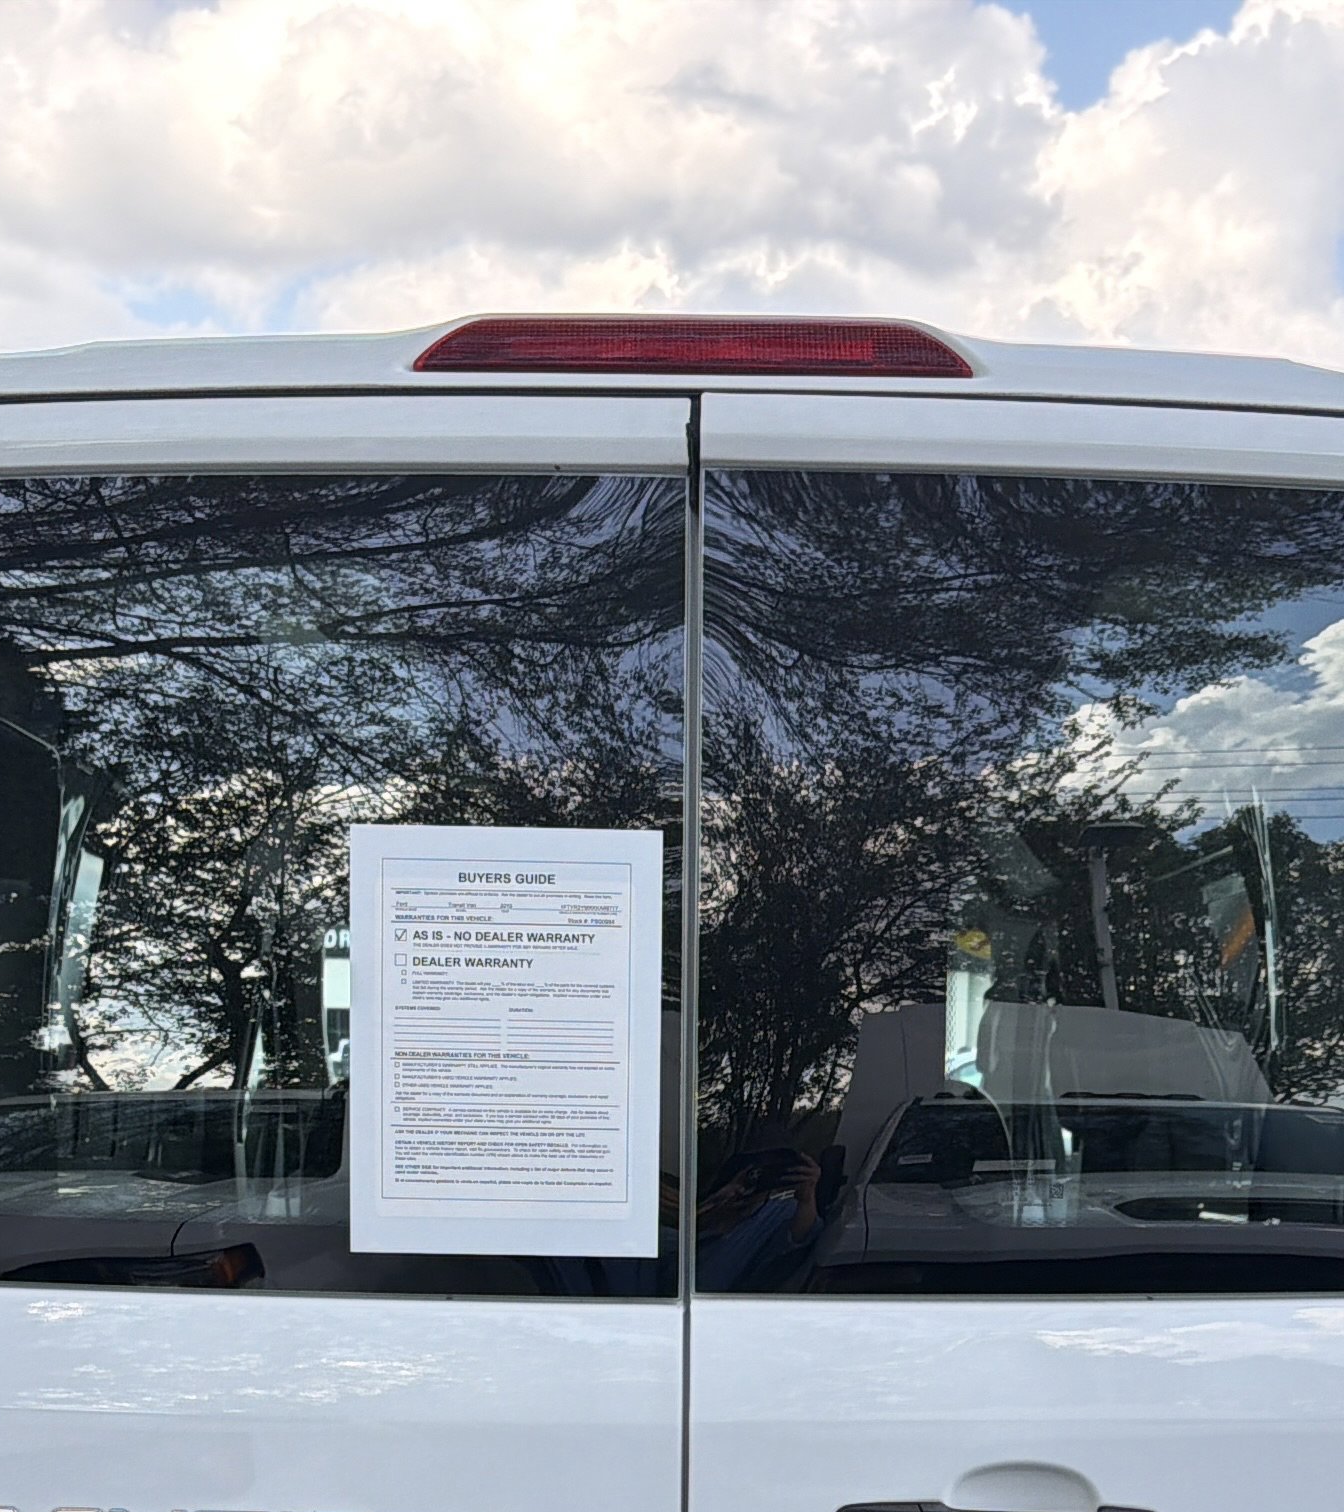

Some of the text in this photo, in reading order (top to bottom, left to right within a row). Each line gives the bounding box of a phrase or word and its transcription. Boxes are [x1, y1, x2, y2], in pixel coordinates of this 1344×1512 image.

[458, 872, 556, 885] BUYERS GUIDE
[413, 930, 428, 940] AS
[432, 930, 443, 940] IS
[454, 931, 471, 941] NO
[475, 931, 523, 942] DEALER
[527, 932, 595, 944] WARRANTY
[412, 956, 534, 968] DEALER WARRANTY
